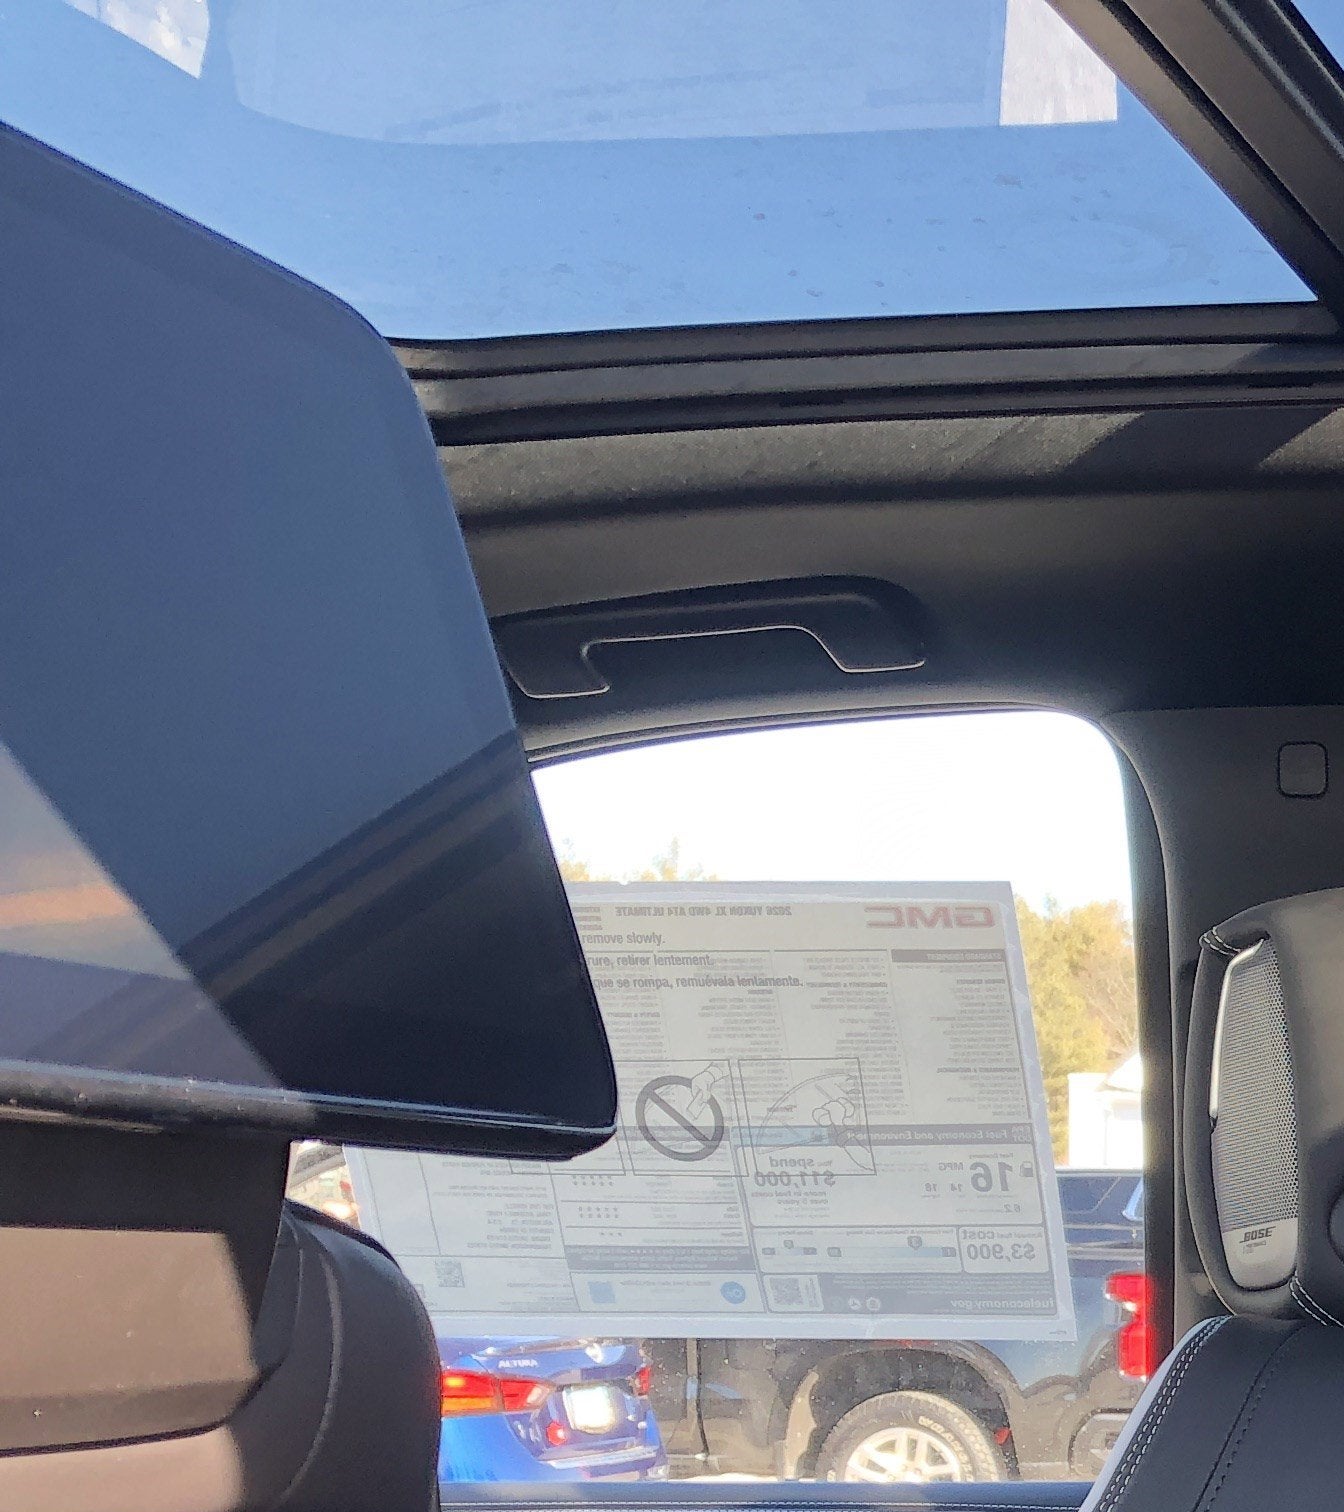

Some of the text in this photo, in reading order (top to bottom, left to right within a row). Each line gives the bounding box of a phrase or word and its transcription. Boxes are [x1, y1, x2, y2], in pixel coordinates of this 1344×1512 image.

[582, 932, 665, 946] remove slowly.
[617, 954, 650, 966] retirer
[593, 979, 614, 991] que
[617, 979, 630, 989] se
[633, 977, 673, 991] rompa,
[676, 975, 735, 987] remuévala
[738, 975, 804, 987] lentamente.
[1239, 1226, 1276, 1243] BOSE
